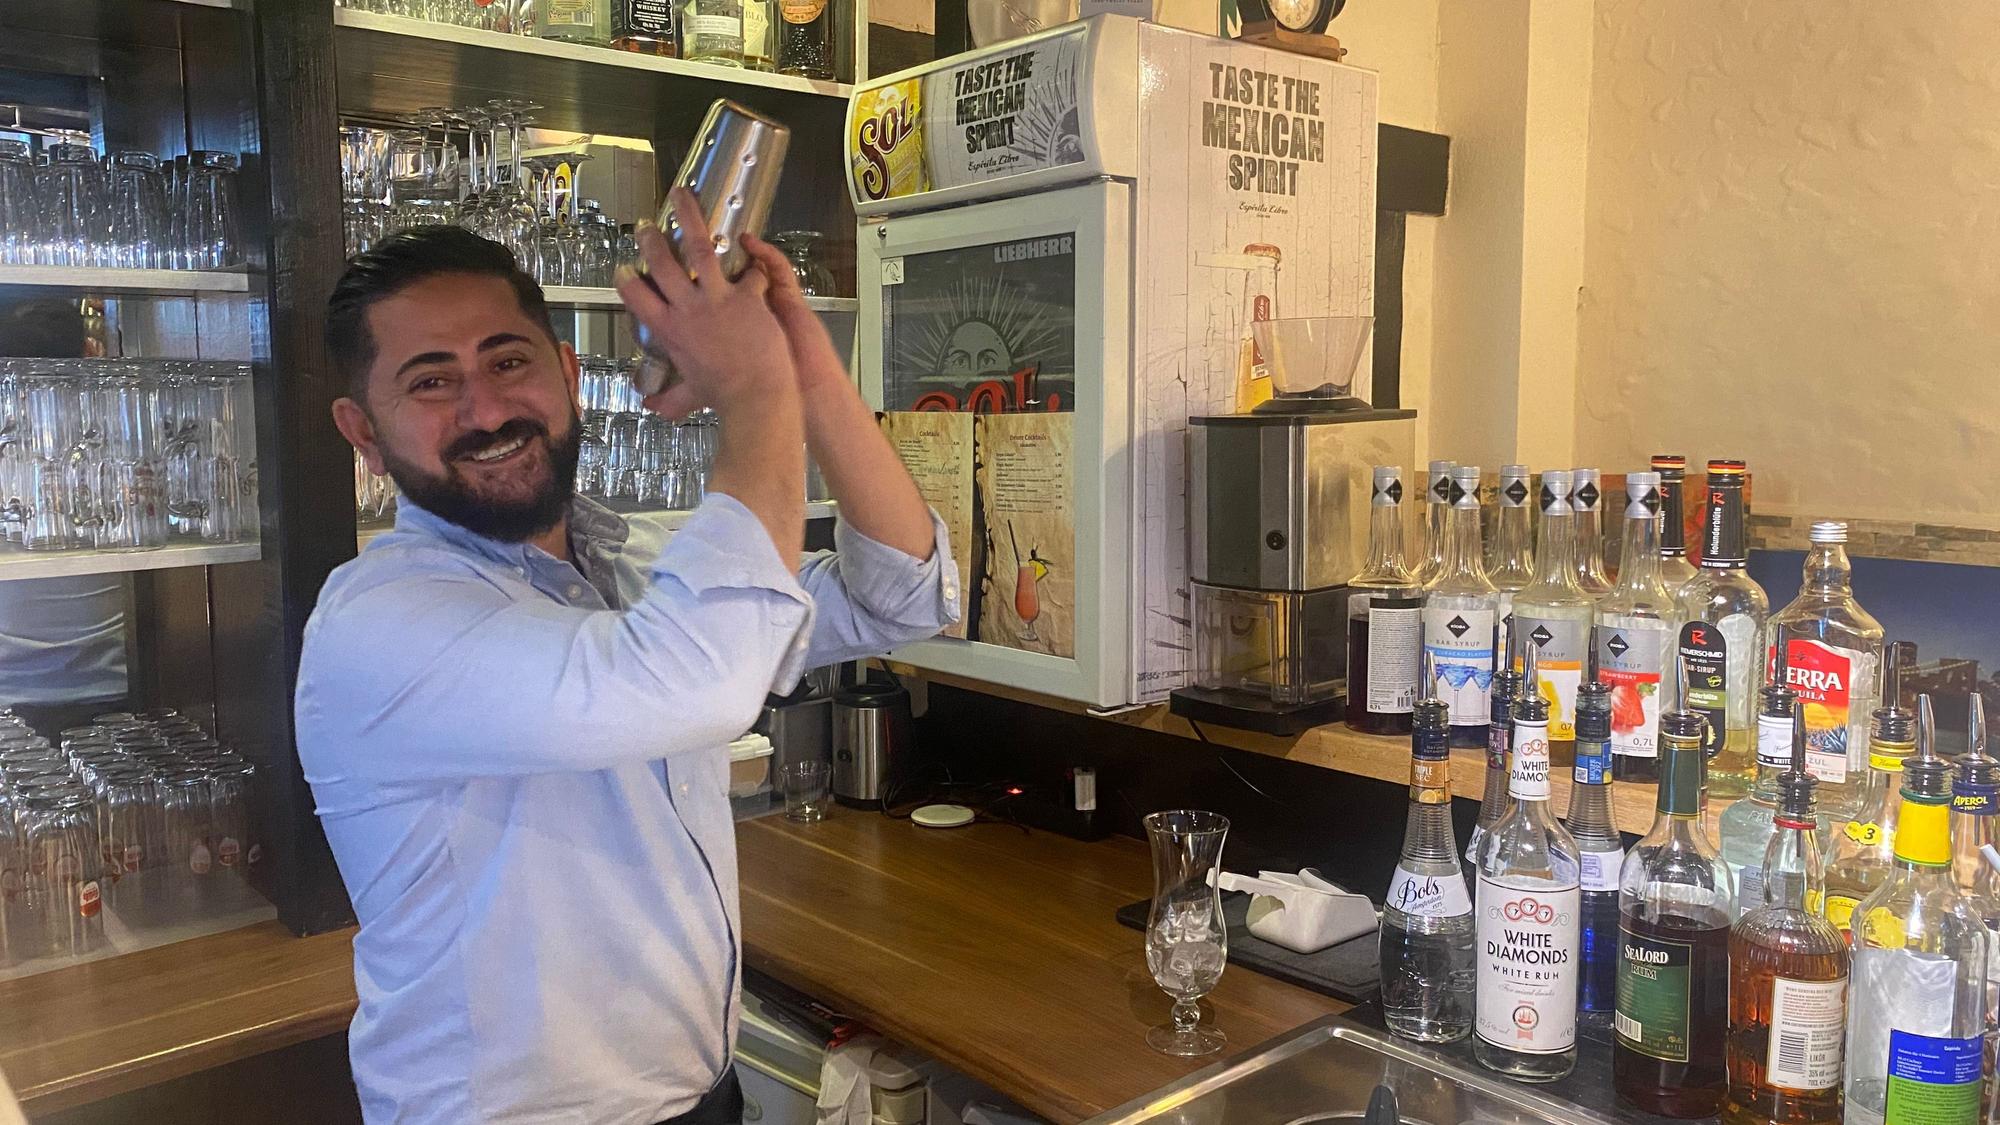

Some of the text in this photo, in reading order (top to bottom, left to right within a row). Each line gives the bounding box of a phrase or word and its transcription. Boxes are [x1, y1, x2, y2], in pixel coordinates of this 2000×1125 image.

[636, 4, 666, 12] WHISKEY
[955, 51, 1035, 97] TASTE THE
[1209, 62, 1320, 116] TASTE THE
[956, 83, 1026, 125] MEXICAN
[965, 116, 1015, 154] SPIRIT
[1202, 101, 1324, 163] MEXICAN
[859, 97, 913, 200] SOL
[1229, 154, 1299, 196] SPIRIT
[993, 236, 1073, 263] LIEBHERR
[1710, 507, 1721, 555] Holunderblüte
[1614, 661, 1642, 669] SYRUP
[1771, 657, 1843, 691] ERRA
[1521, 760, 1548, 771] WHITE
[1953, 795, 1988, 806] APEROL
[1864, 827, 1875, 839] 3
[1395, 876, 1440, 909] Bols
[1487, 940, 1568, 965] DIAMONDS
[1504, 929, 1552, 948] WHITE
[1492, 963, 1530, 979] WHITE
[1631, 964, 1657, 980] RUM
